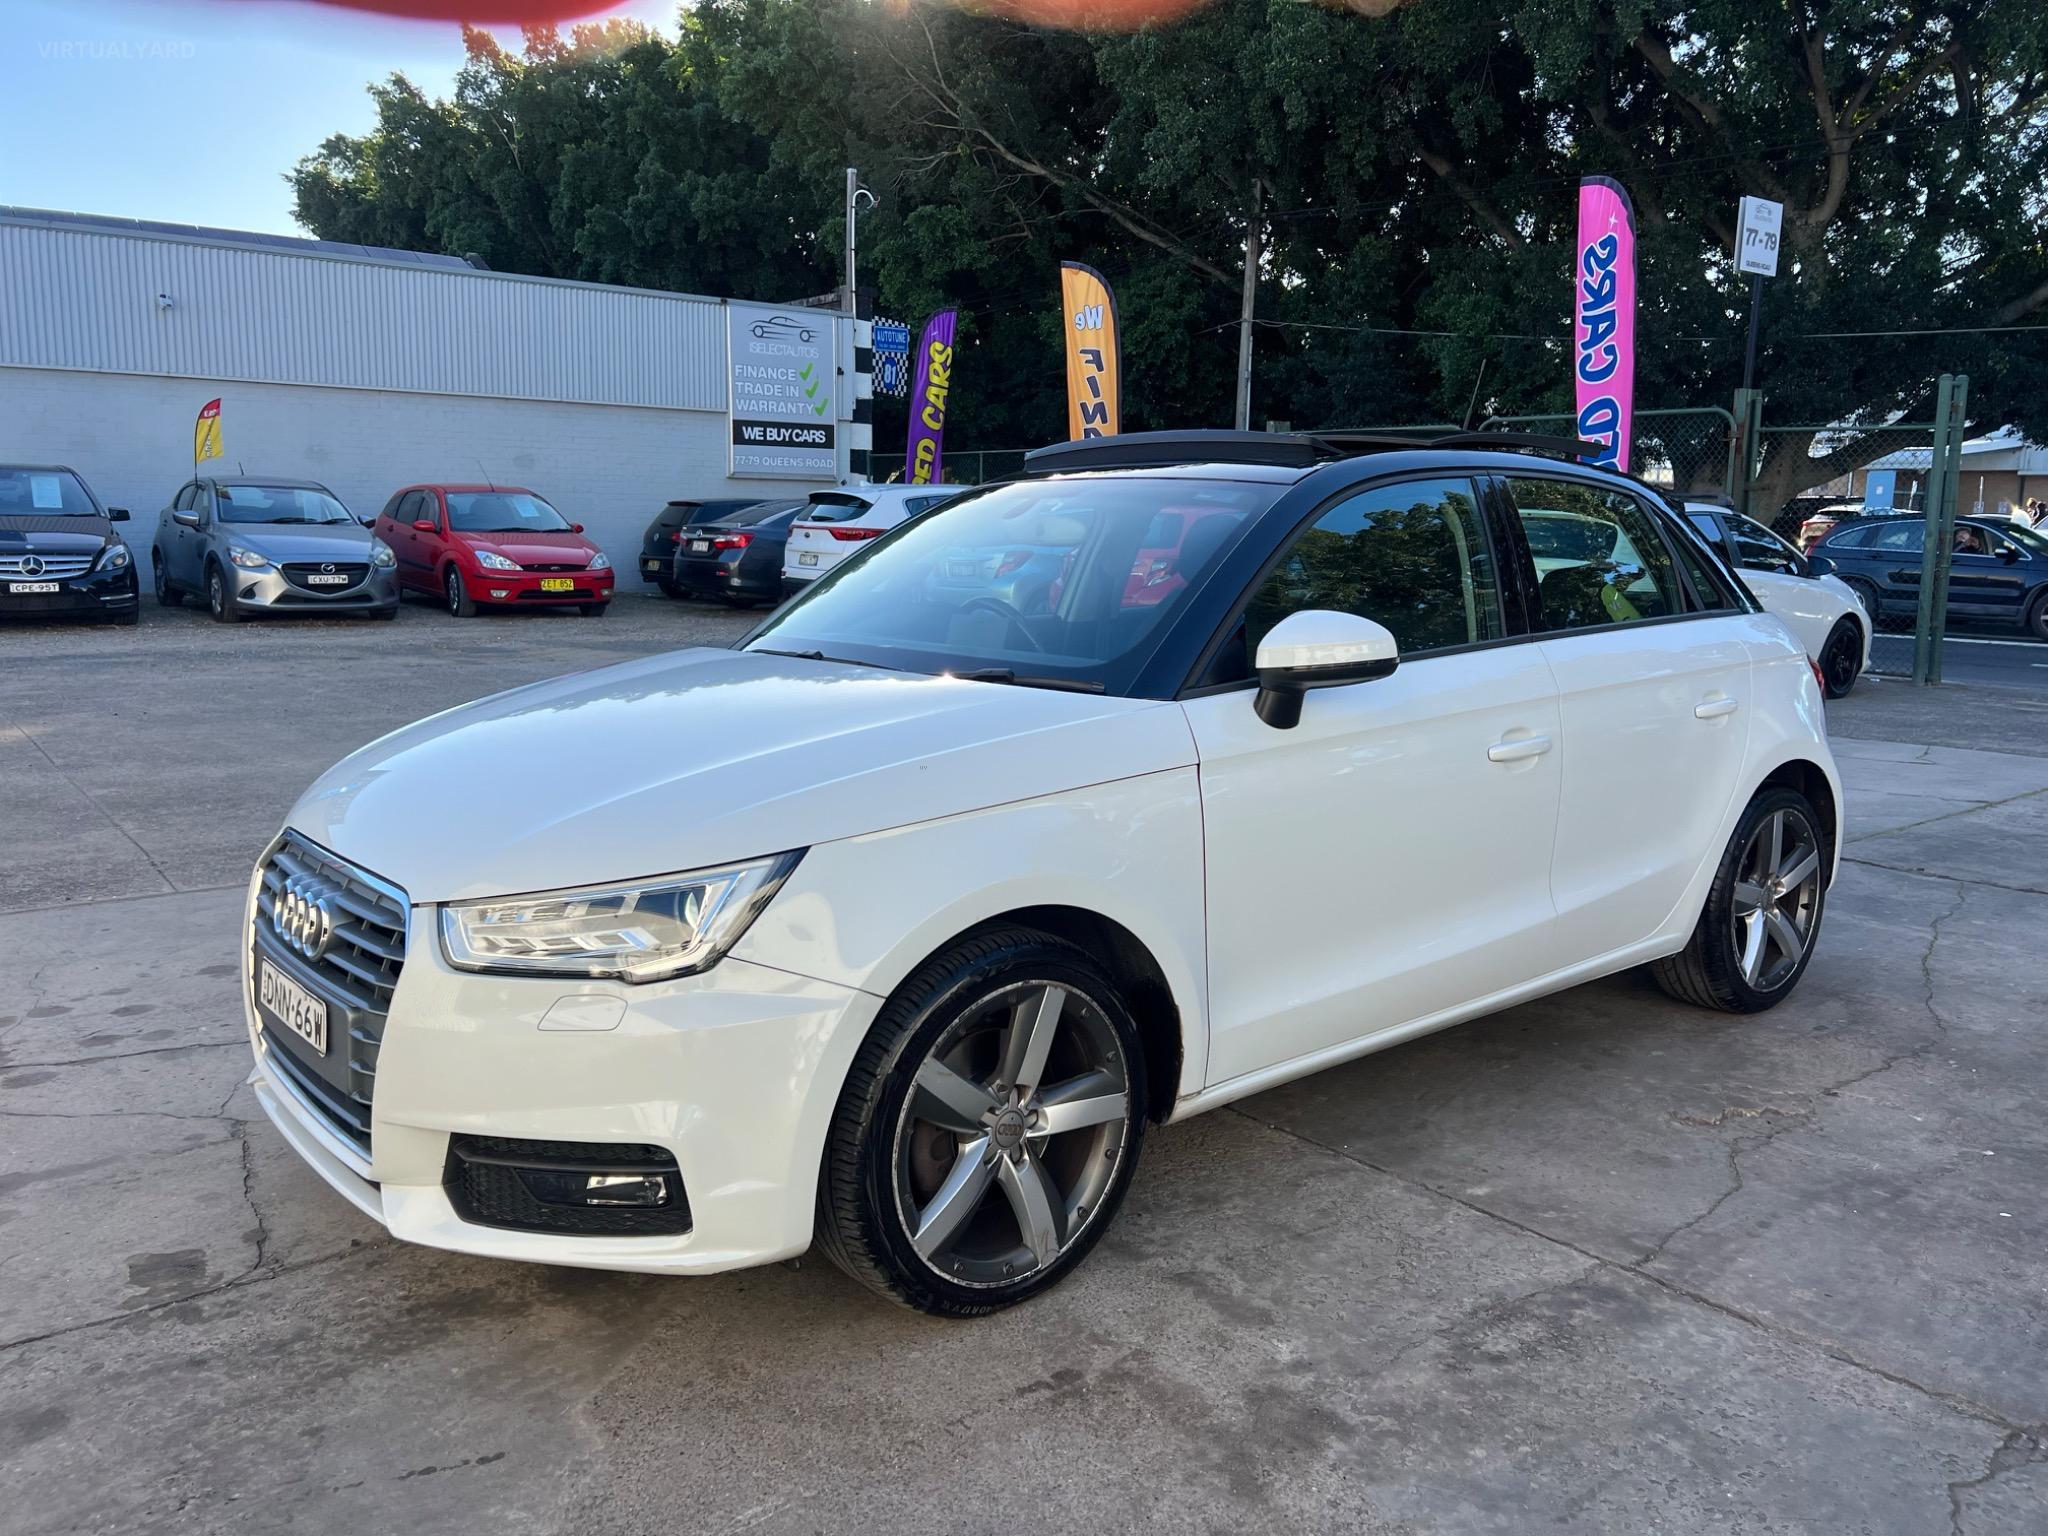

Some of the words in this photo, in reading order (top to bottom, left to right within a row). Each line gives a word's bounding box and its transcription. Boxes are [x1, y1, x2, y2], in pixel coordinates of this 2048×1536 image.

[877, 330, 906, 344] AUTOTUNE
[735, 364, 796, 381] FINANCE
[883, 363, 897, 386] 81
[735, 381, 783, 397] TRADE
[786, 385, 799, 398] IN
[922, 340, 953, 431] CARS
[736, 398, 815, 415] WARRANTY
[742, 426, 764, 441] WE
[766, 427, 791, 442] BUY
[792, 429, 826, 444] CARS
[735, 455, 760, 466] 77-79
[762, 456, 803, 468] QUEENS
[806, 457, 834, 469] ROAD
